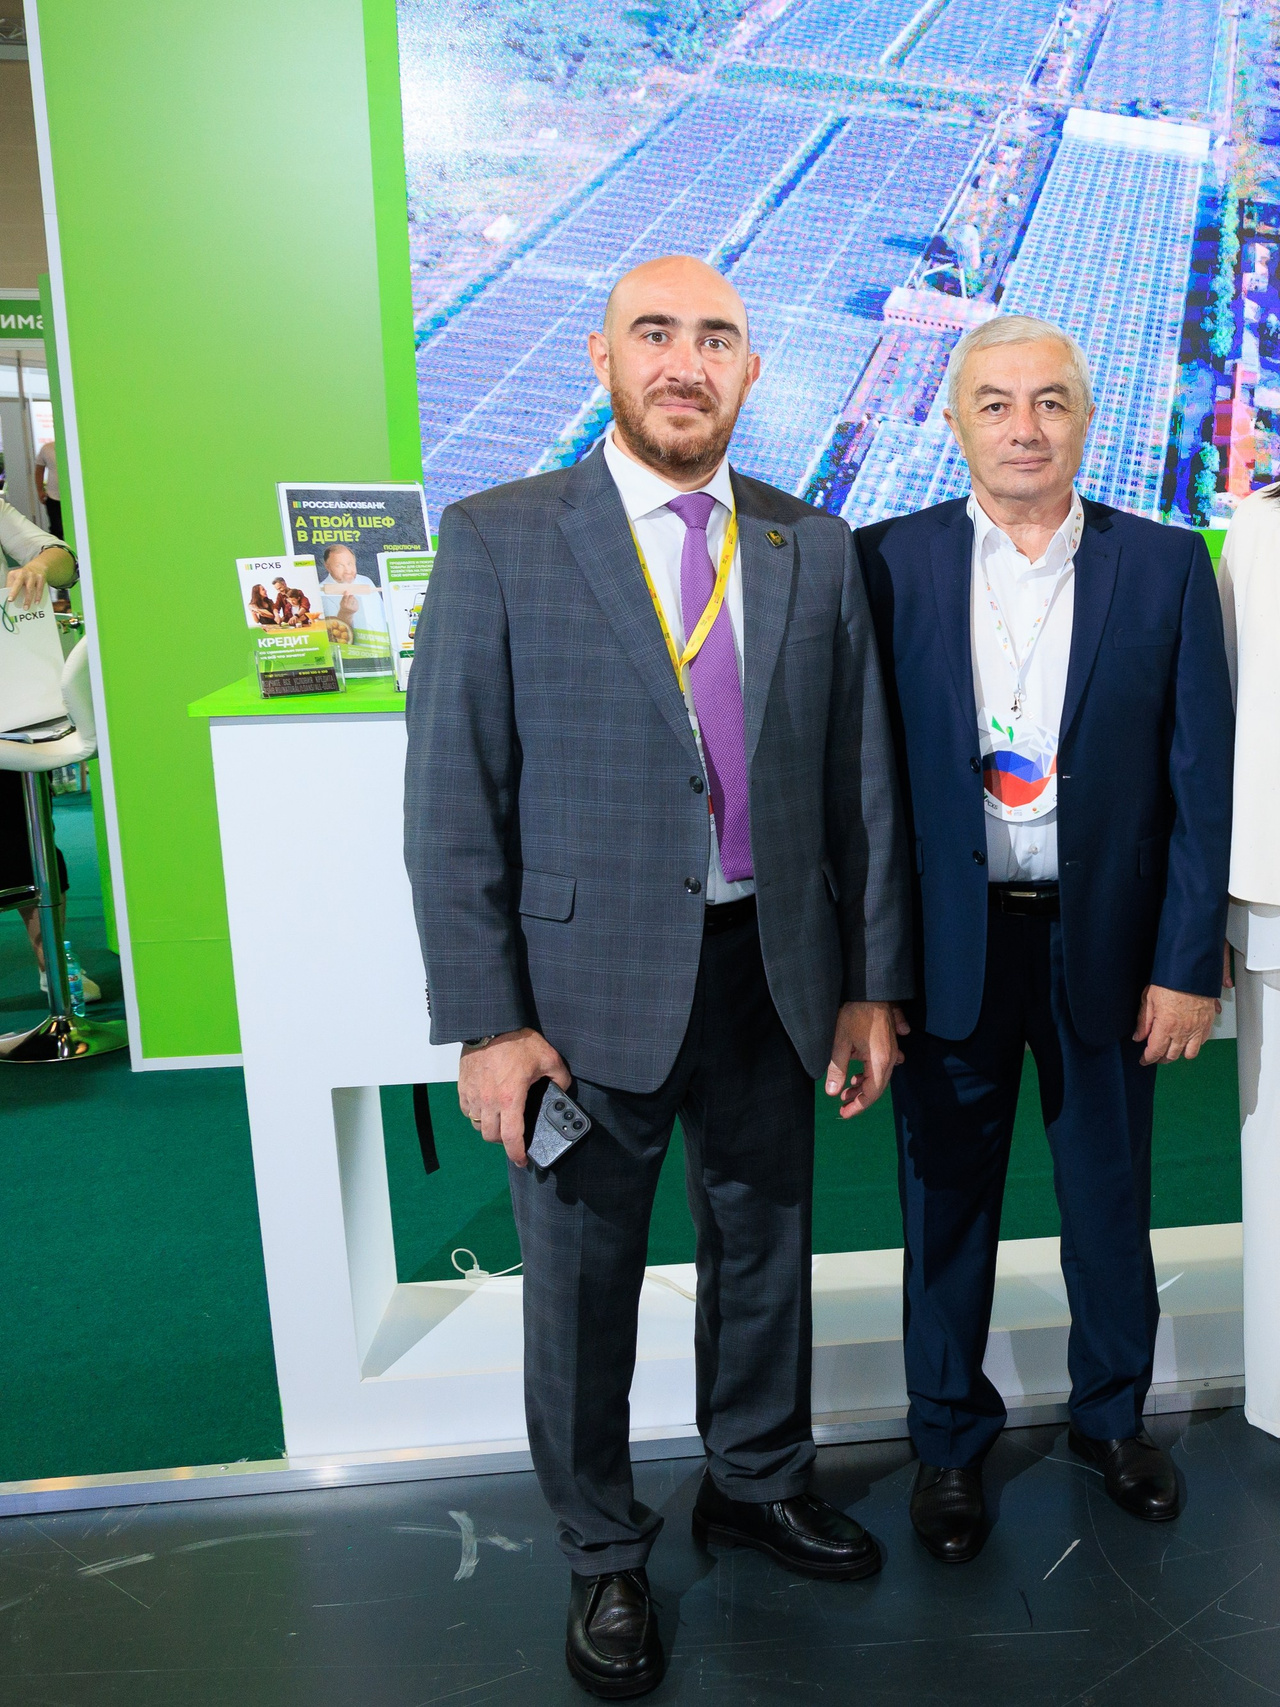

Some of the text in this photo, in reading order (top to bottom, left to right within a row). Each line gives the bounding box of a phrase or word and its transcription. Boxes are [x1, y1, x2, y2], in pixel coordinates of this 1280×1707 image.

[302, 500, 386, 510] РОССЕЛЬХОЗБАНК
[295, 513, 396, 528] А ТВОЙ ШЕФ
[297, 530, 361, 544] В ДЕЛЕ?
[255, 561, 282, 570] РСХБ
[19, 610, 45, 622] РСХБ
[257, 635, 310, 648] КРЕДИТ
